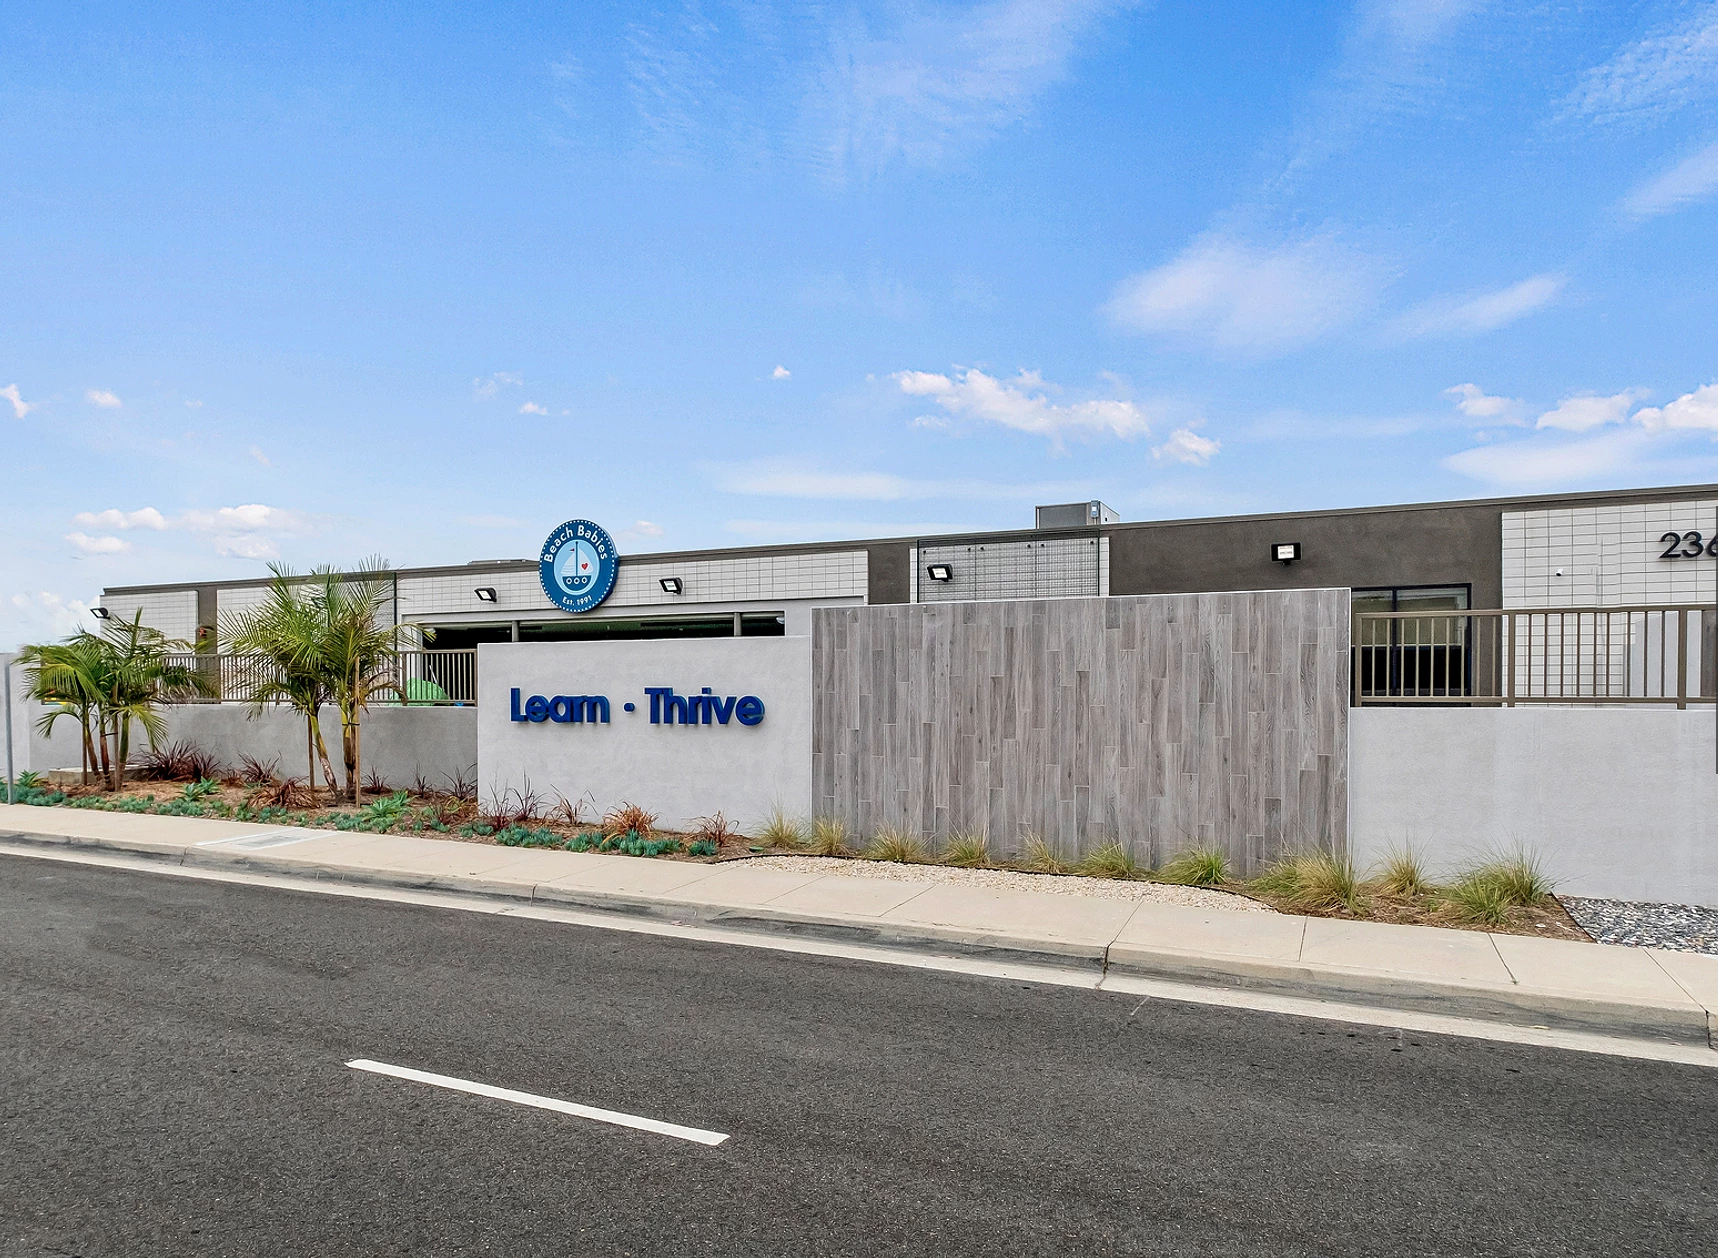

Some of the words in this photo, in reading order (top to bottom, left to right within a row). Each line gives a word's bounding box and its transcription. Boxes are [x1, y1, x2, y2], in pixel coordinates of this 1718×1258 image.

[543, 526, 574, 563] Beach
[577, 525, 607, 560] Babies
[562, 596, 575, 606] Est.
[510, 687, 611, 724] Learn
[644, 687, 766, 726] Thrive
